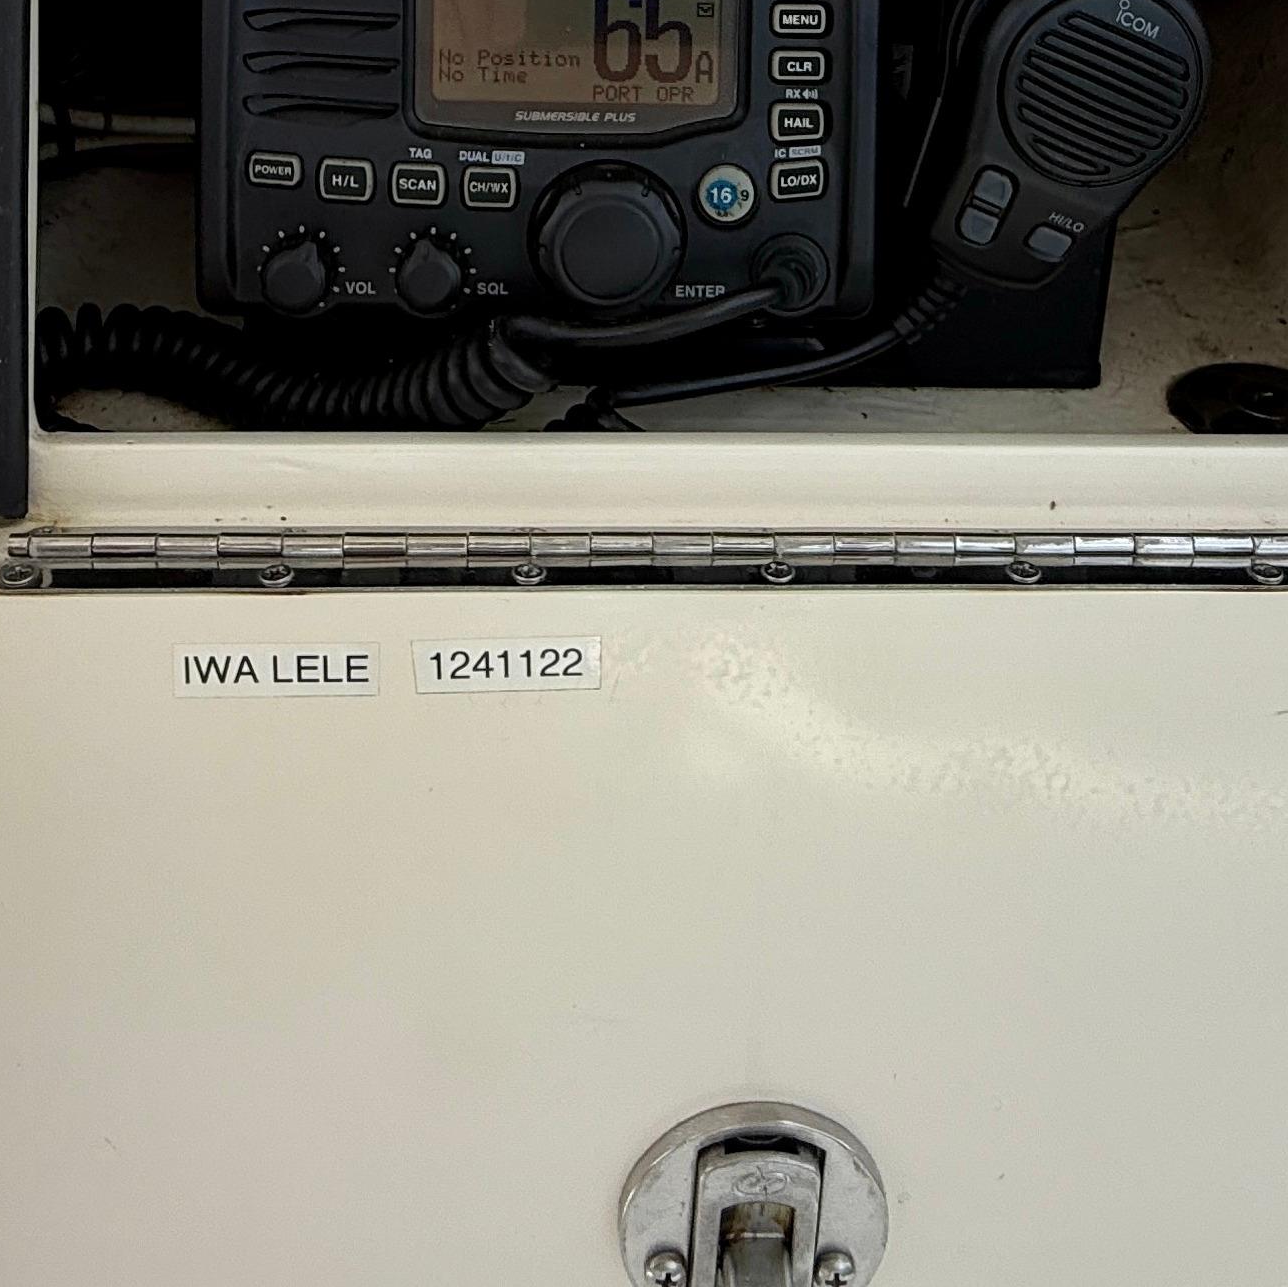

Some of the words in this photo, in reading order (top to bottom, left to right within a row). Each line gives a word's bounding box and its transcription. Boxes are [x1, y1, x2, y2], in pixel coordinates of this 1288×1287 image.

[782, 15, 818, 26] MENU
[439, 51, 464, 67] No
[478, 50, 580, 68] Position
[787, 61, 812, 73] CLR
[439, 68, 464, 83] No
[480, 68, 527, 84] Time
[592, 86, 642, 102] PORT
[657, 87, 694, 103] OPR
[785, 88, 801, 99] RX
[515, 111, 600, 123] SUBMERSIBLE
[604, 112, 636, 123] PLUS
[784, 117, 813, 129] HAIL
[408, 148, 432, 159] TAG
[459, 151, 490, 162] DUAL
[775, 148, 786, 158] IC
[254, 164, 292, 177] POWER
[332, 173, 359, 189] H/L
[398, 177, 437, 191] SCAN
[469, 181, 509, 195] CH/WX
[780, 174, 817, 188] LO/DX
[710, 187, 732, 205] 16
[740, 189, 750, 203] 9
[1048, 212, 1084, 233] HI/LO
[345, 281, 377, 295] VOL
[477, 282, 509, 296] SQL
[184, 654, 259, 685] IWA
[273, 654, 369, 683] LELE
[429, 647, 583, 680] 1241122
